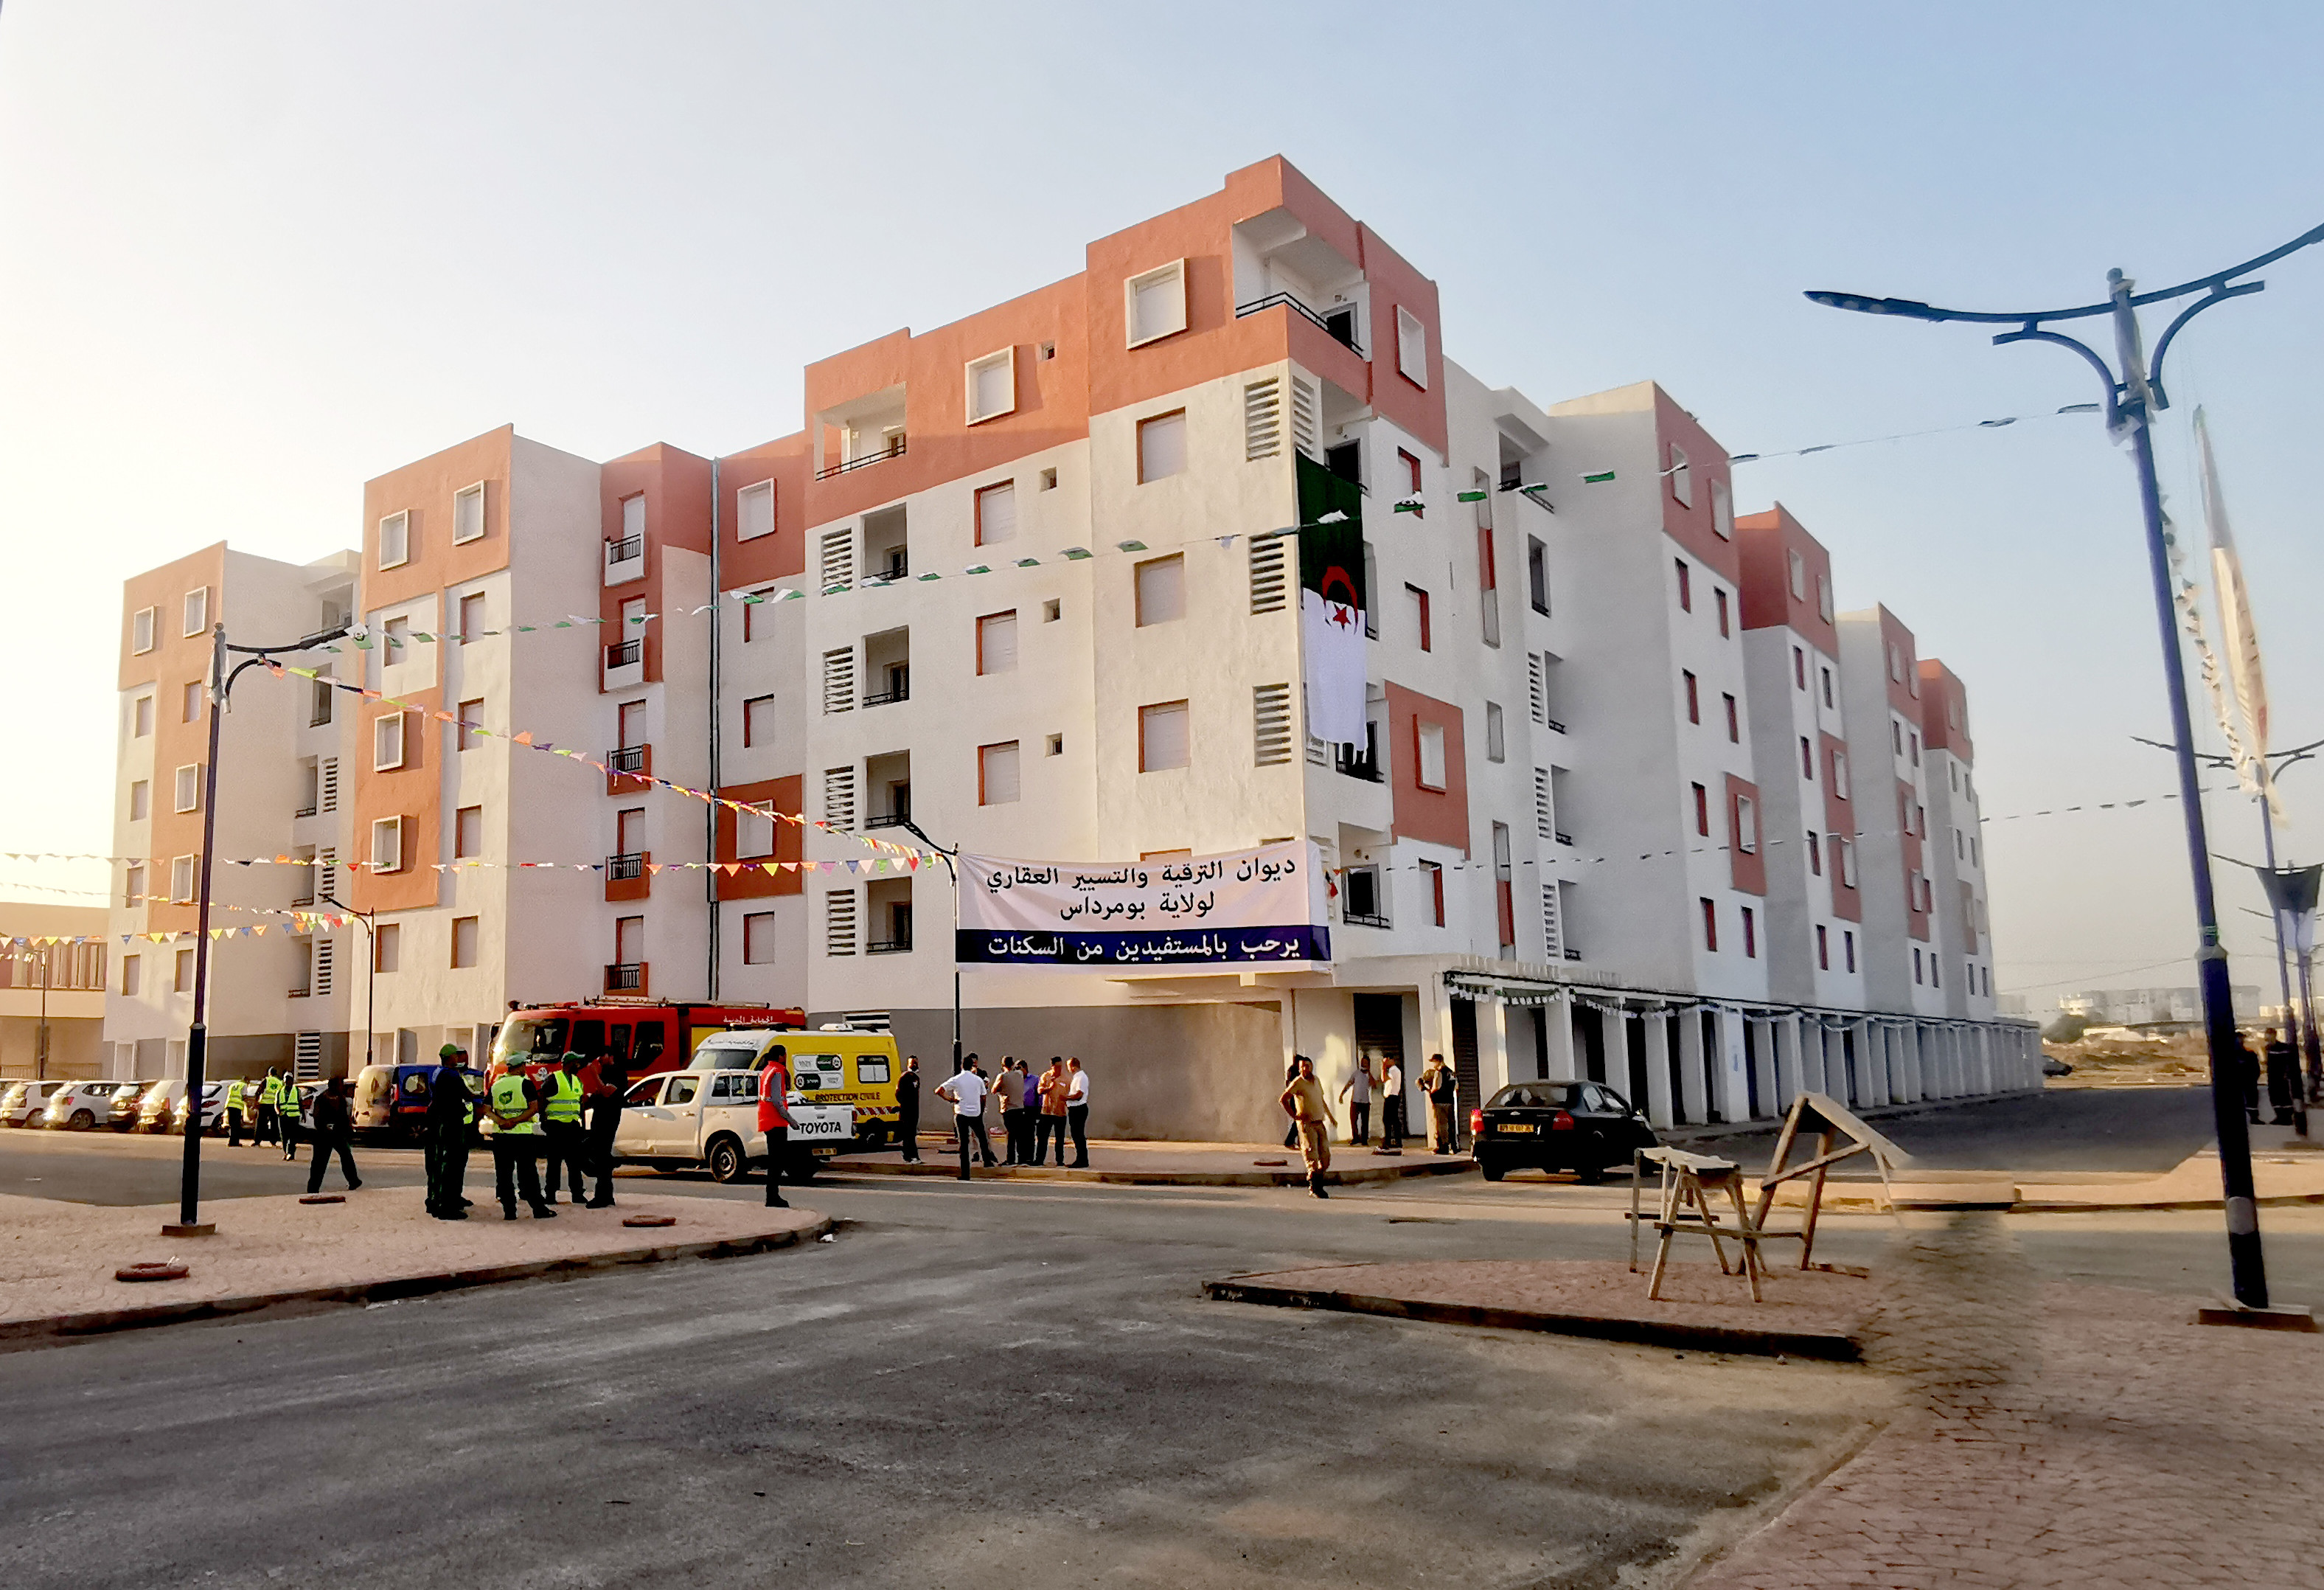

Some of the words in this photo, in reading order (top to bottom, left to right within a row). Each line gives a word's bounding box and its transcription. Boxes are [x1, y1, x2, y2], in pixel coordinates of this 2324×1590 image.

[987, 867, 1059, 895] العقاري
[1072, 868, 1148, 892] والتسيير
[1162, 861, 1222, 886] الترقية
[1237, 858, 1295, 883] ديوان
[1060, 897, 1145, 921] بومرداس
[1160, 892, 1214, 919] لولاية
[989, 936, 1064, 955] السكنات
[1077, 942, 1103, 961] من
[1116, 934, 1230, 963] بالمستفيدين
[1242, 939, 1300, 960] يرحب
[815, 1093, 858, 1102] PROTECTION
[859, 1092, 881, 1100] CIVILE
[799, 1122, 841, 1134] TOYOTA
